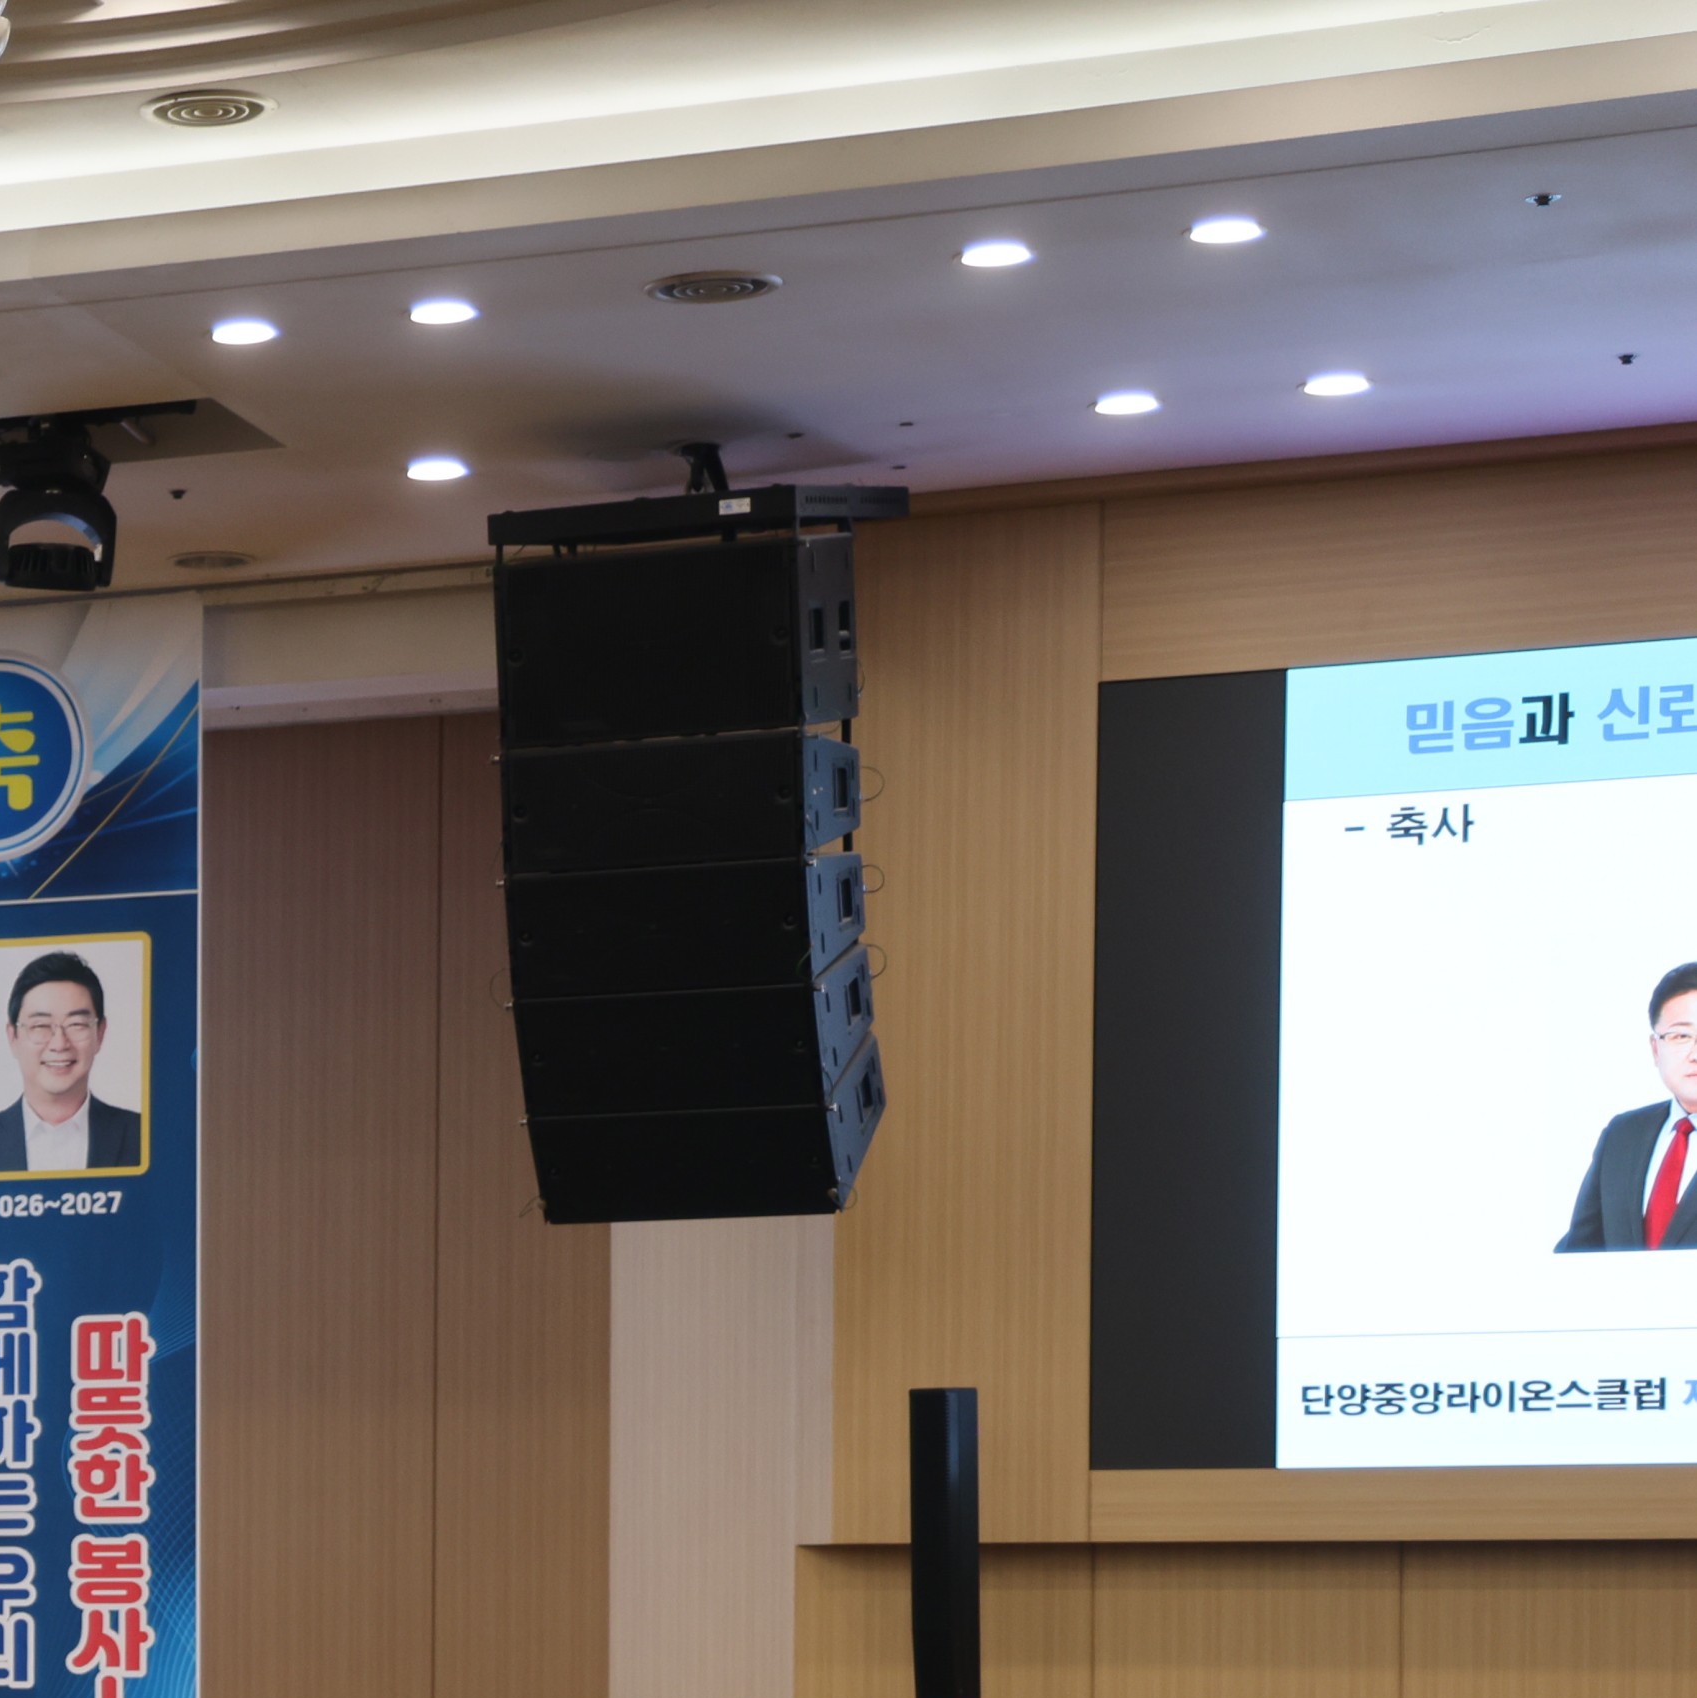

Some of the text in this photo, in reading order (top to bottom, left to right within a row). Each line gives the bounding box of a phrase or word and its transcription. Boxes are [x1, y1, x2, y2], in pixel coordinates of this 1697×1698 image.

[1406, 692, 1575, 755] 믿음과
[1386, 803, 1475, 846] 축사
[70, 1312, 156, 1524] 따뜻한
[1301, 1377, 1667, 1416] 단양중앙라이온스클럽
